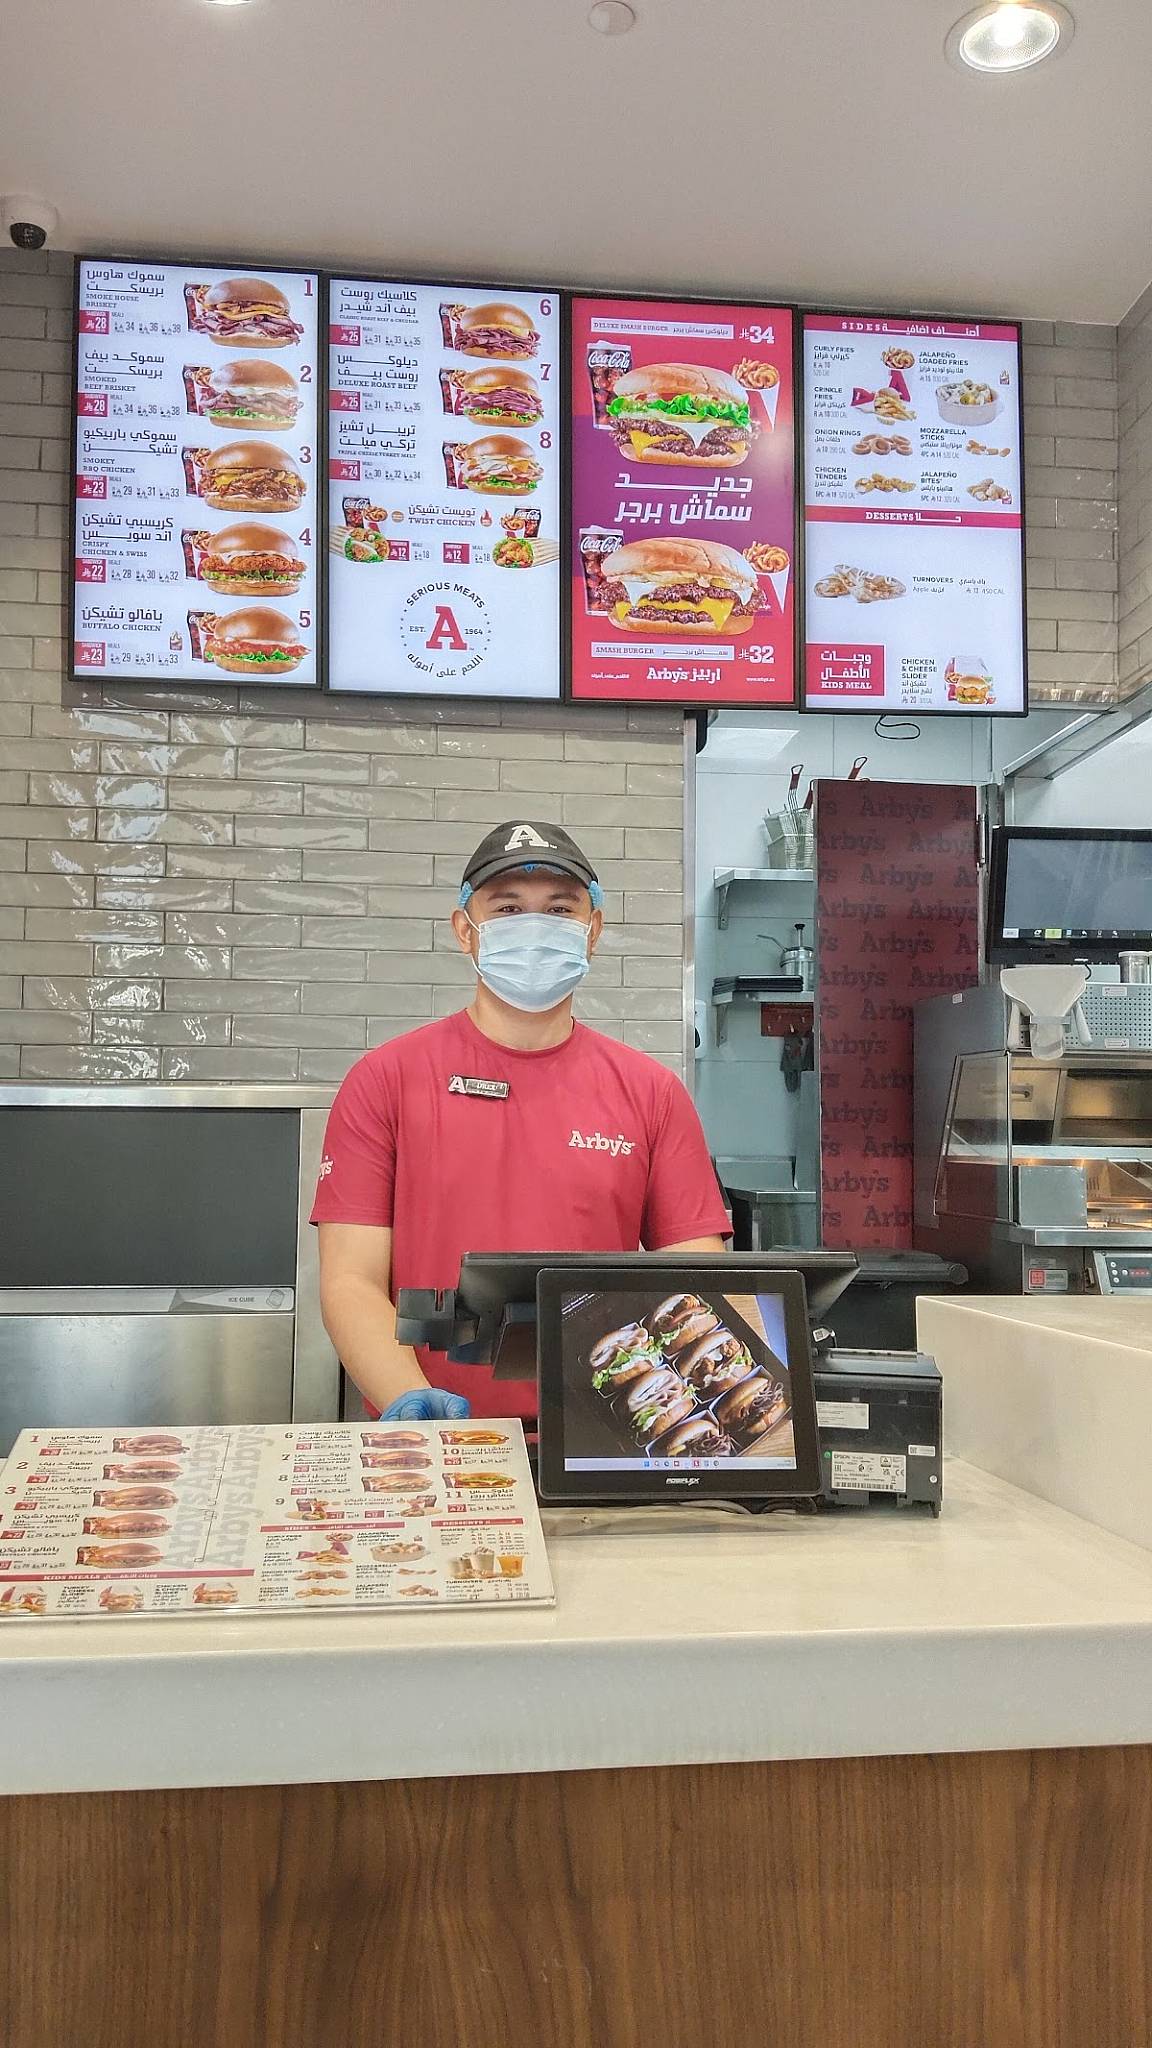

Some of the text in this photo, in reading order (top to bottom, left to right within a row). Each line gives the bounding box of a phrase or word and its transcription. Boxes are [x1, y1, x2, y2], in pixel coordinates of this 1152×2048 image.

[87, 269, 165, 283] سموك هاوس
[304, 279, 313, 297] 1
[341, 287, 374, 300] روست
[340, 301, 372, 314] شيدر
[394, 305, 416, 317] بيف
[540, 299, 552, 316] 6
[95, 317, 107, 326] 28
[841, 322, 880, 331] SIDES
[749, 325, 775, 344] 34
[85, 350, 108, 363] بيف
[338, 355, 418, 368] ديلوكس
[588, 351, 631, 371] Coca-Cola
[300, 365, 312, 383] 2
[338, 367, 418, 382] روست بيف
[540, 364, 552, 381] 7
[338, 379, 369, 387] DELUXE
[339, 420, 364, 433] تشيز
[130, 430, 177, 442] سموكي
[540, 432, 552, 448] 8
[83, 441, 178, 456] تشيكن
[380, 439, 416, 451] تركي
[300, 446, 312, 463] 3
[348, 466, 358, 476] 24
[93, 481, 104, 494] 23
[614, 473, 753, 499] جديد
[408, 503, 475, 518] تويست تشيكن
[614, 494, 752, 525] سماش برجر
[865, 511, 914, 521] DESSERTS
[82, 512, 174, 530] كريسبي تشيكن
[408, 517, 476, 527] TWIST CHICKEN
[82, 530, 151, 543] سويس
[299, 528, 312, 545] 4
[398, 548, 406, 557] 12
[453, 550, 462, 560] 12
[92, 565, 103, 576] 22
[406, 582, 485, 608] SERIOUS MEATS
[82, 605, 124, 621] تشيكن
[299, 611, 311, 628] 5
[122, 624, 162, 632] CHICKEN
[426, 605, 468, 650] A
[91, 649, 103, 660] 23
[749, 645, 775, 664] 32
[820, 650, 872, 664] وجبات
[647, 667, 689, 683] Arby's
[820, 664, 870, 681] الأطفال
[820, 681, 872, 689] KIDS MEAL
[504, 824, 550, 851] A
[448, 1075, 467, 1094] A
[568, 1130, 633, 1157] Arby's
[17, 1462, 29, 1470] 2
[5, 1486, 17, 1495] 3
